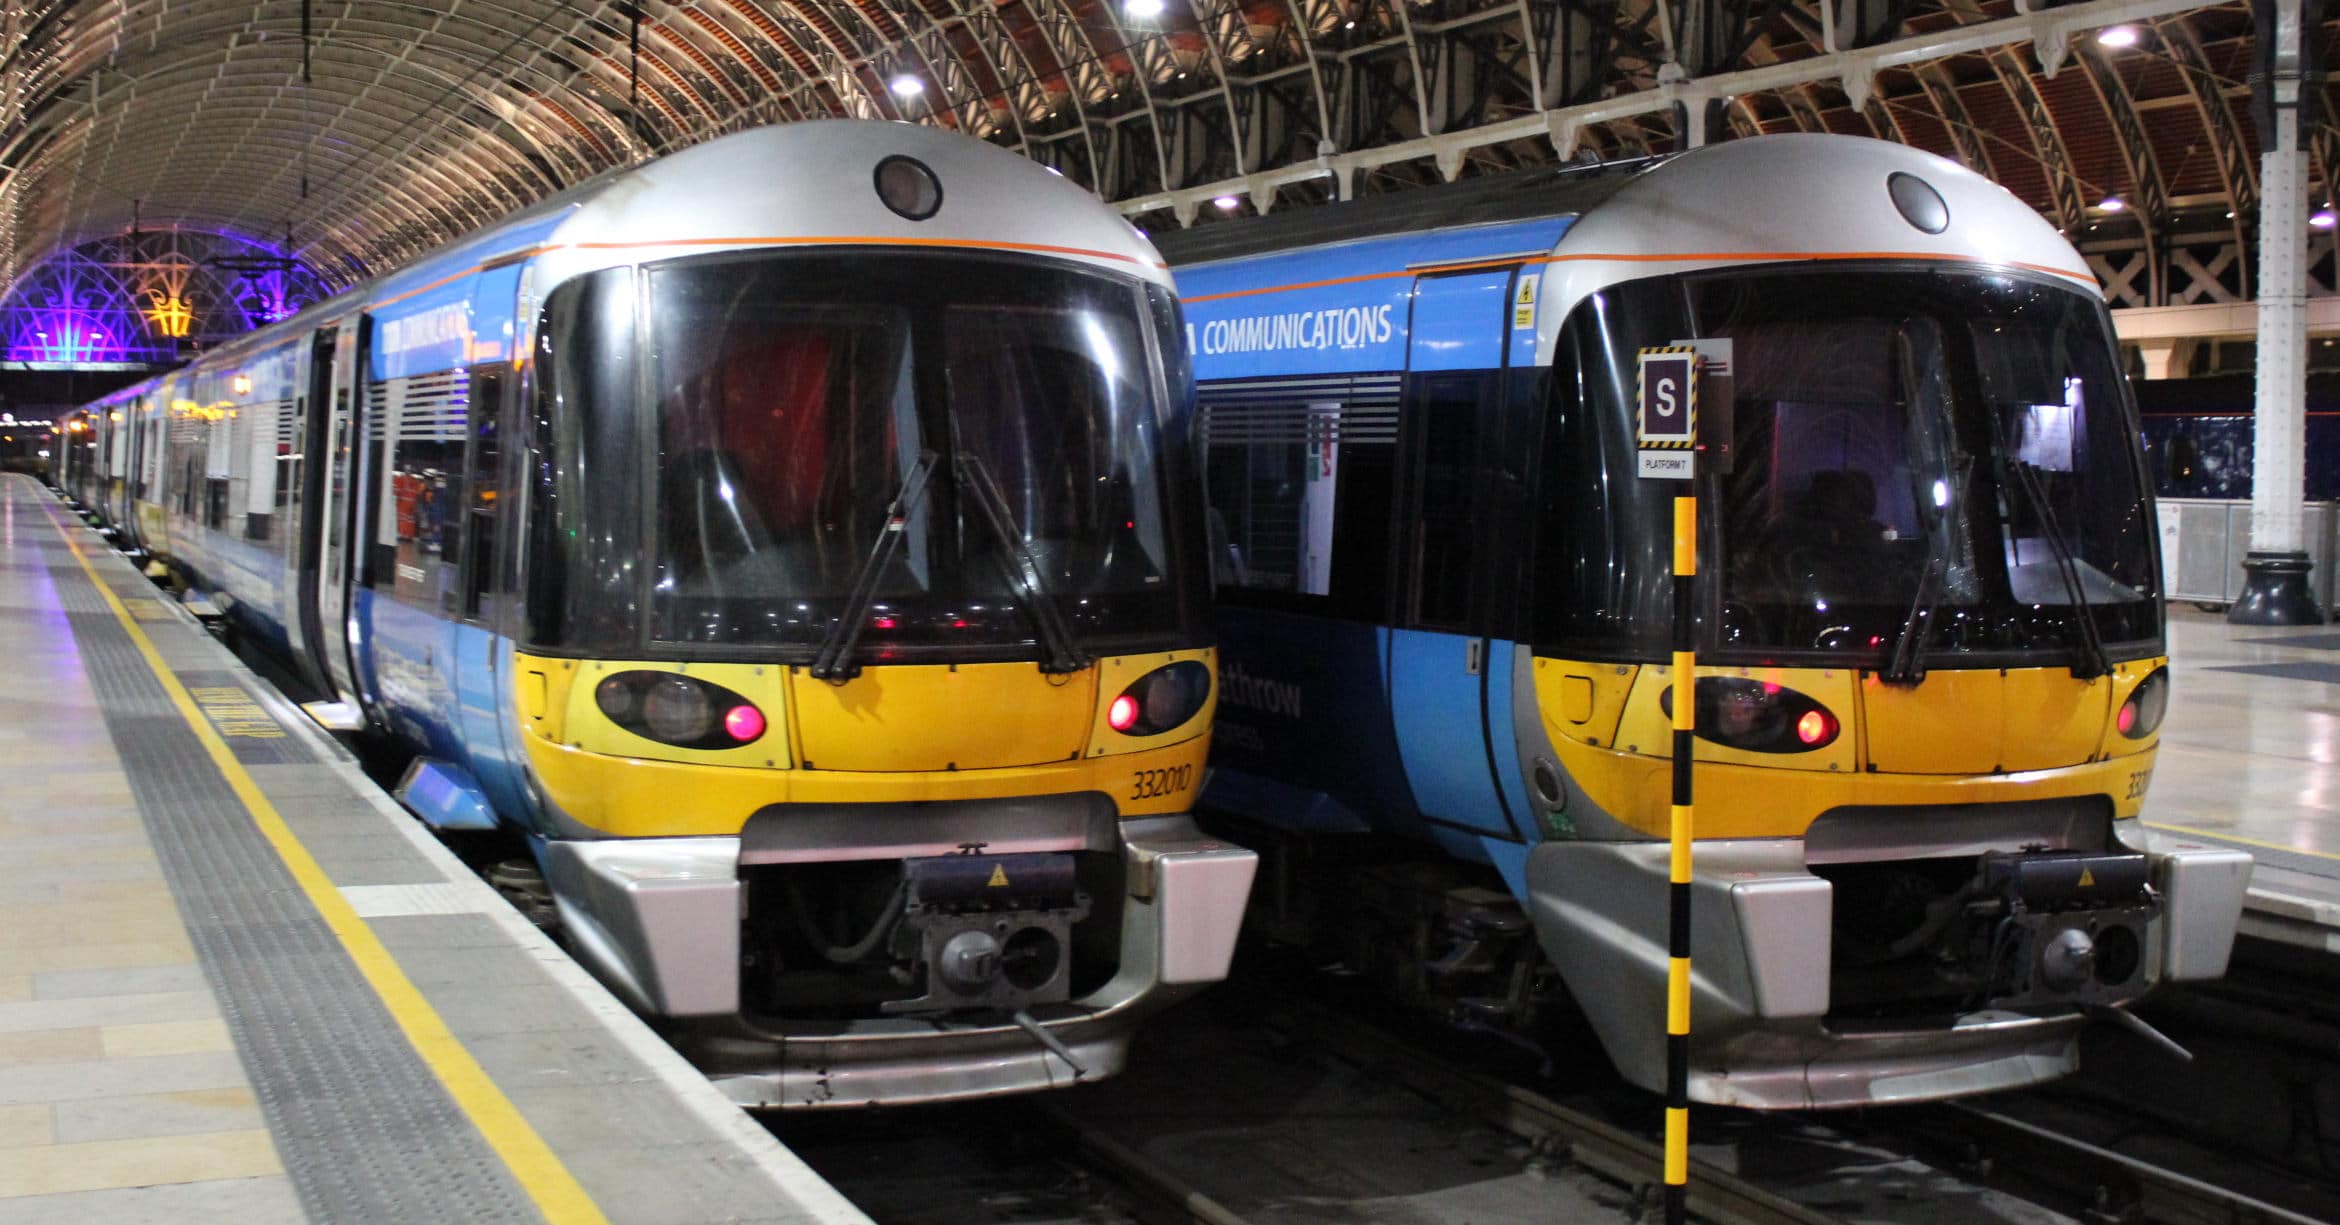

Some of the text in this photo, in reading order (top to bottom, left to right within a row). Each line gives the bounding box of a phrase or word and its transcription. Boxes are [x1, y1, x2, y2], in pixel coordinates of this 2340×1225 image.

[1203, 304, 1393, 355] COMMUNICATIONS
[1656, 377, 1676, 417] S
[1645, 459, 1681, 470] PLATFORM
[1130, 762, 1192, 800] 332010
